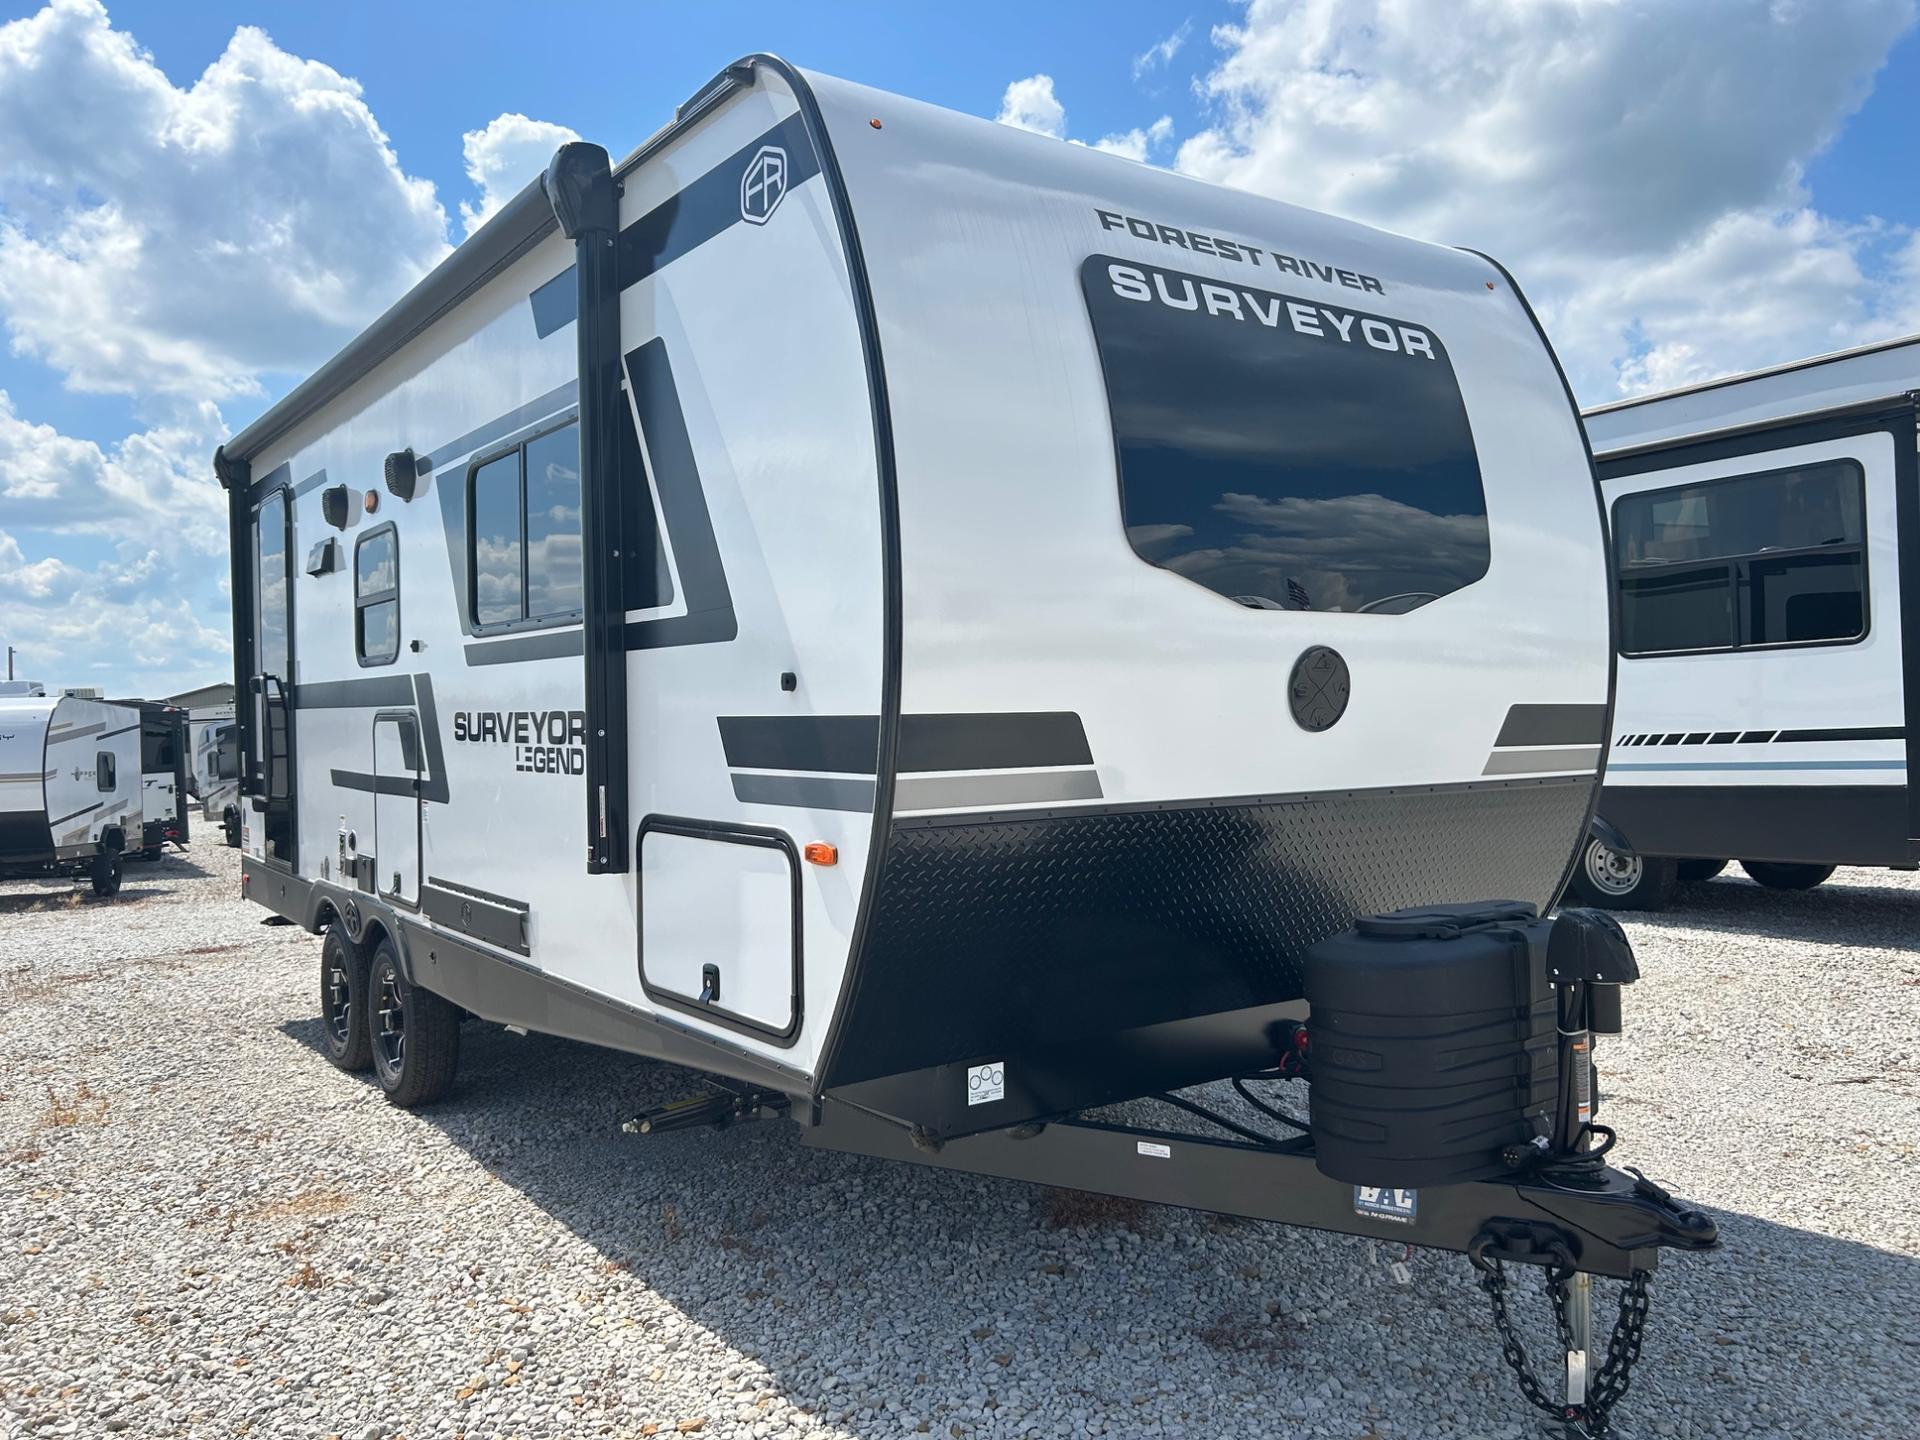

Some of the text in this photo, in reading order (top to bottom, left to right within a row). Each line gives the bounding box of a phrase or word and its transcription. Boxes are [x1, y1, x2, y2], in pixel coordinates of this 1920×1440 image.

[1093, 208, 1387, 296] FOREST RIVER
[1108, 264, 1436, 361] SURVEYOR
[454, 710, 586, 745] SURVEYOR
[515, 745, 585, 776] LEGEND
